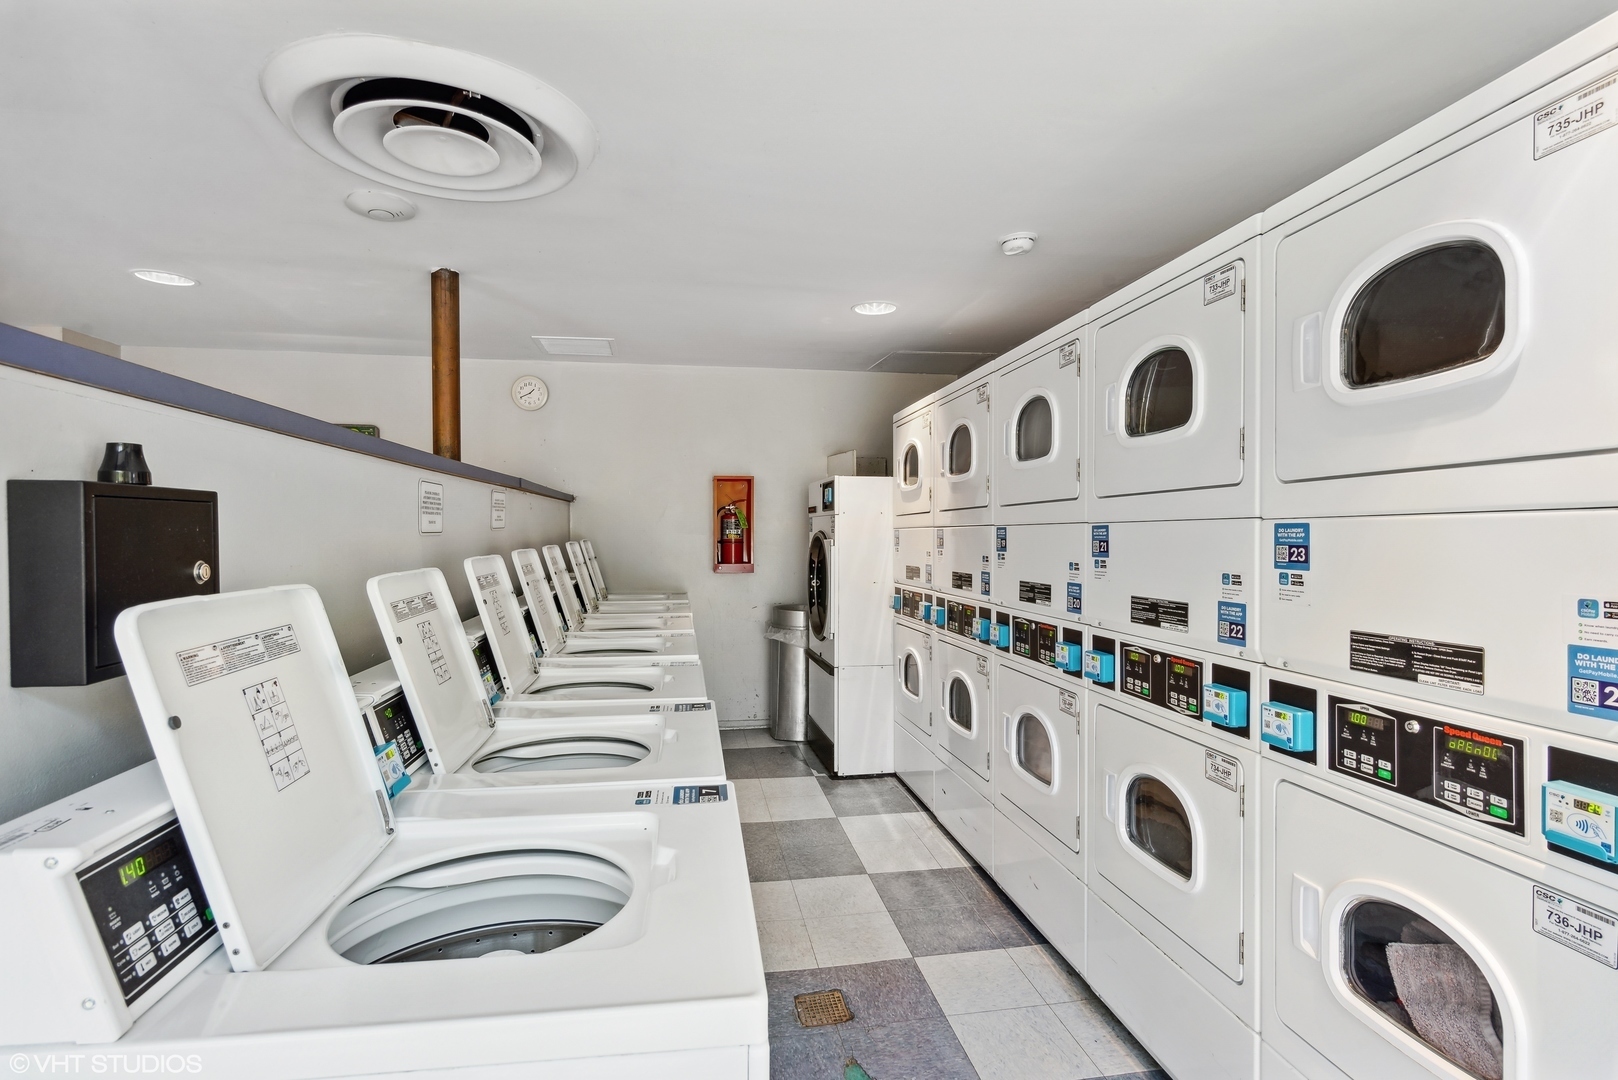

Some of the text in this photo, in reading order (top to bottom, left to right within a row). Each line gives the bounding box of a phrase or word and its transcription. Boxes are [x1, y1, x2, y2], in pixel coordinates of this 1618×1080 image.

[1537, 108, 1557, 121] CSC
[1547, 102, 1604, 136] 735-JHP
[1100, 542, 1106, 551] 21
[1290, 548, 1305, 561] 23
[1073, 600, 1080, 608] 20
[1231, 625, 1243, 638] 22
[1575, 659, 1616, 671] WITH THE
[1444, 725, 1504, 747] Speed Queen
[1211, 763, 1231, 777] 734-JHP
[1466, 810, 1479, 818] LOWER
[1588, 803, 1602, 815] 24
[1536, 890, 1556, 902] CSC
[1546, 909, 1603, 940] 736-JHP
